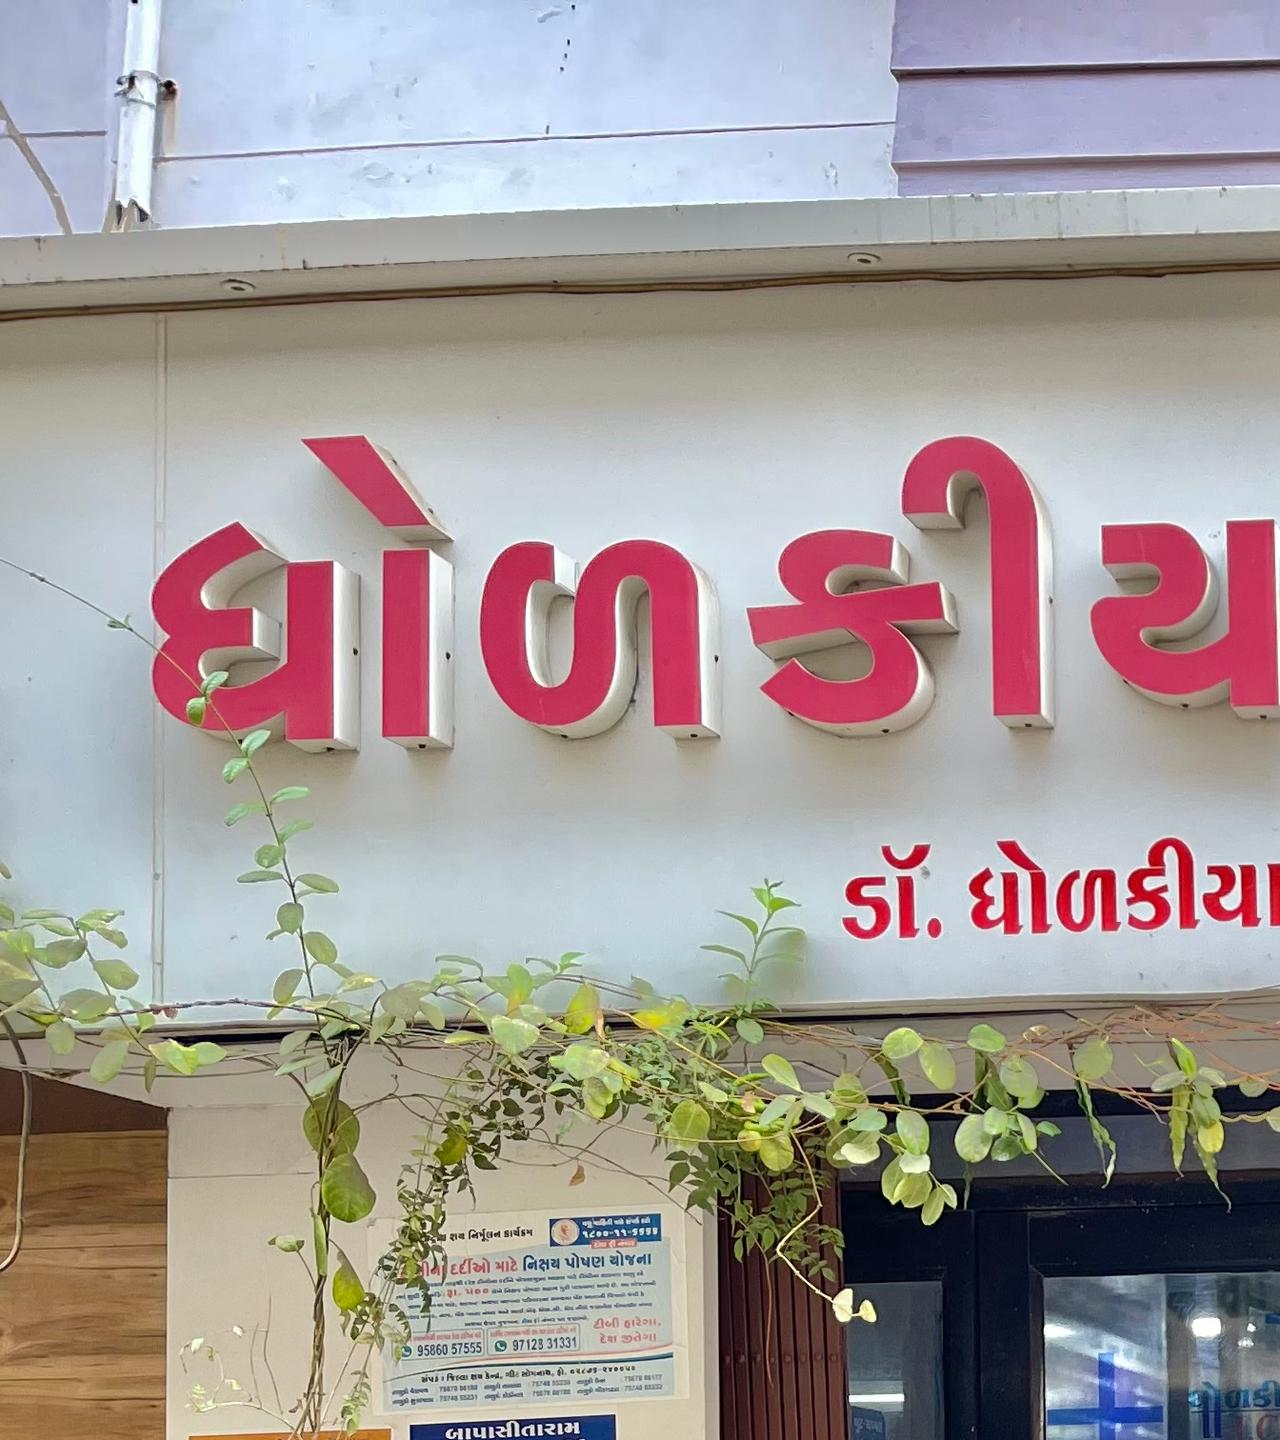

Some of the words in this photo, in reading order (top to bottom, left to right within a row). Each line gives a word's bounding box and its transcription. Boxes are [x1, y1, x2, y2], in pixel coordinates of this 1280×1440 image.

[841, 843, 943, 940] ડૉ.
[495, 1255, 518, 1273] માટે
[522, 1253, 561, 1273] નિક્ષય
[564, 1252, 605, 1270] પોષણ
[609, 1249, 652, 1267] યોજના
[417, 1343, 448, 1357] 95860
[451, 1341, 482, 1355] 57555
[512, 1338, 544, 1352] 97128
[547, 1335, 578, 1350] 31331
[444, 1419, 581, 1440] બાપાસીતારામ
